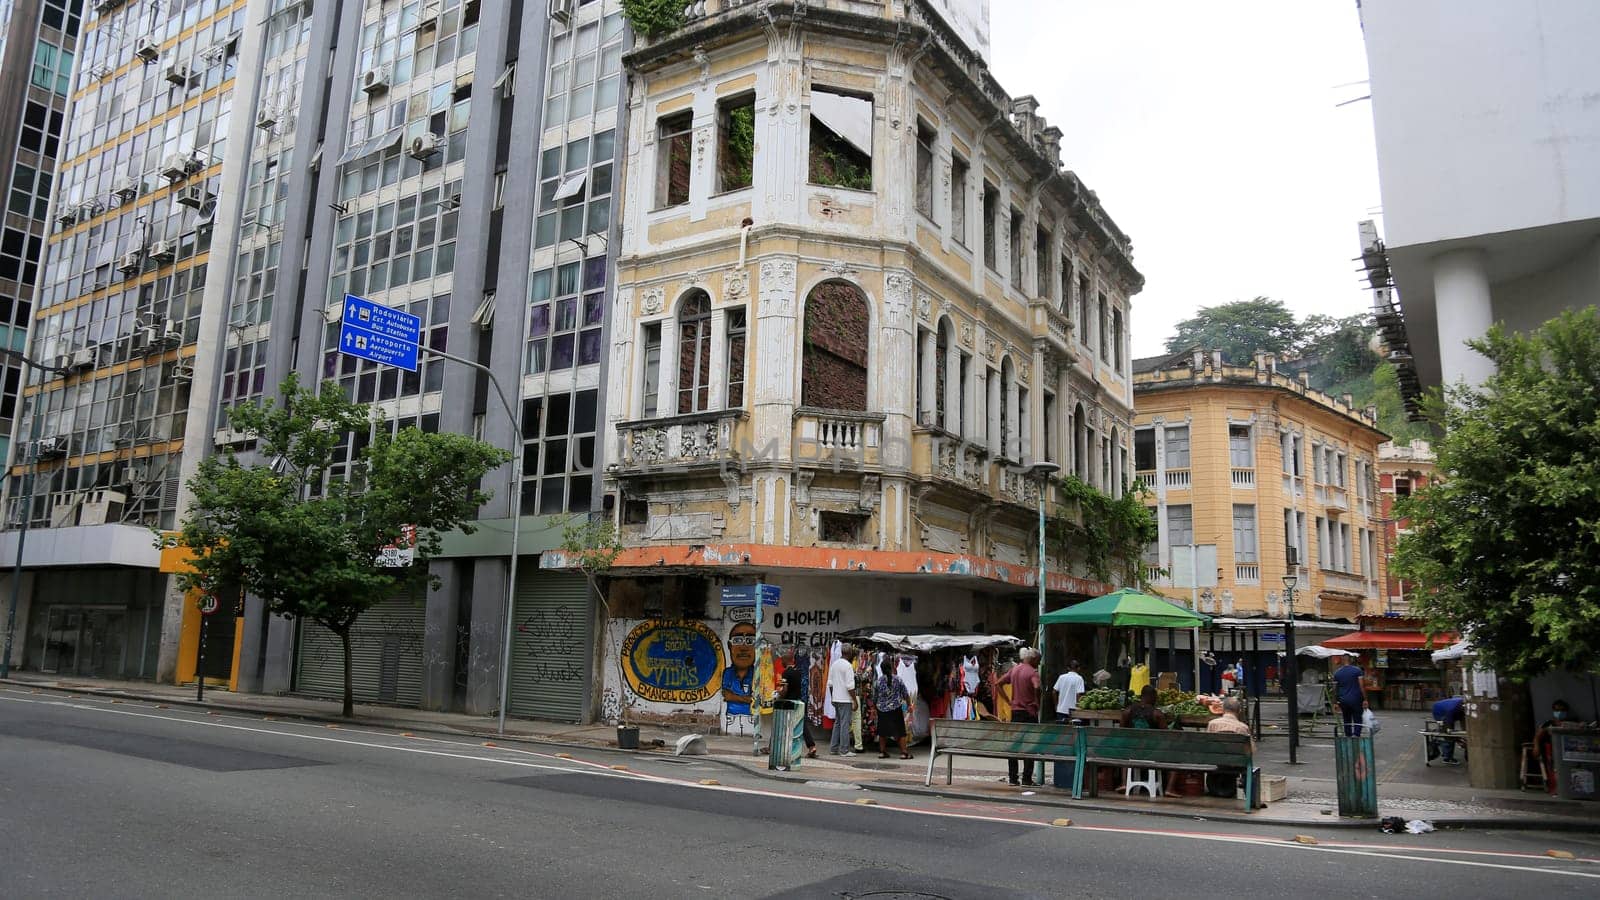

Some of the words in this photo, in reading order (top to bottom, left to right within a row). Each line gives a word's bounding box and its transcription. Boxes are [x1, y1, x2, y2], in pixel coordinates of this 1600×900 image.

[372, 316, 385, 324] Est.
[387, 320, 416, 334] Autobuses
[372, 324, 384, 332] Bus
[386, 327, 408, 338] Station
[370, 335, 411, 352] Aeroporto
[369, 352, 393, 362] Airport
[651, 666, 699, 686] VIDAS
[680, 686, 710, 702] COSTA
